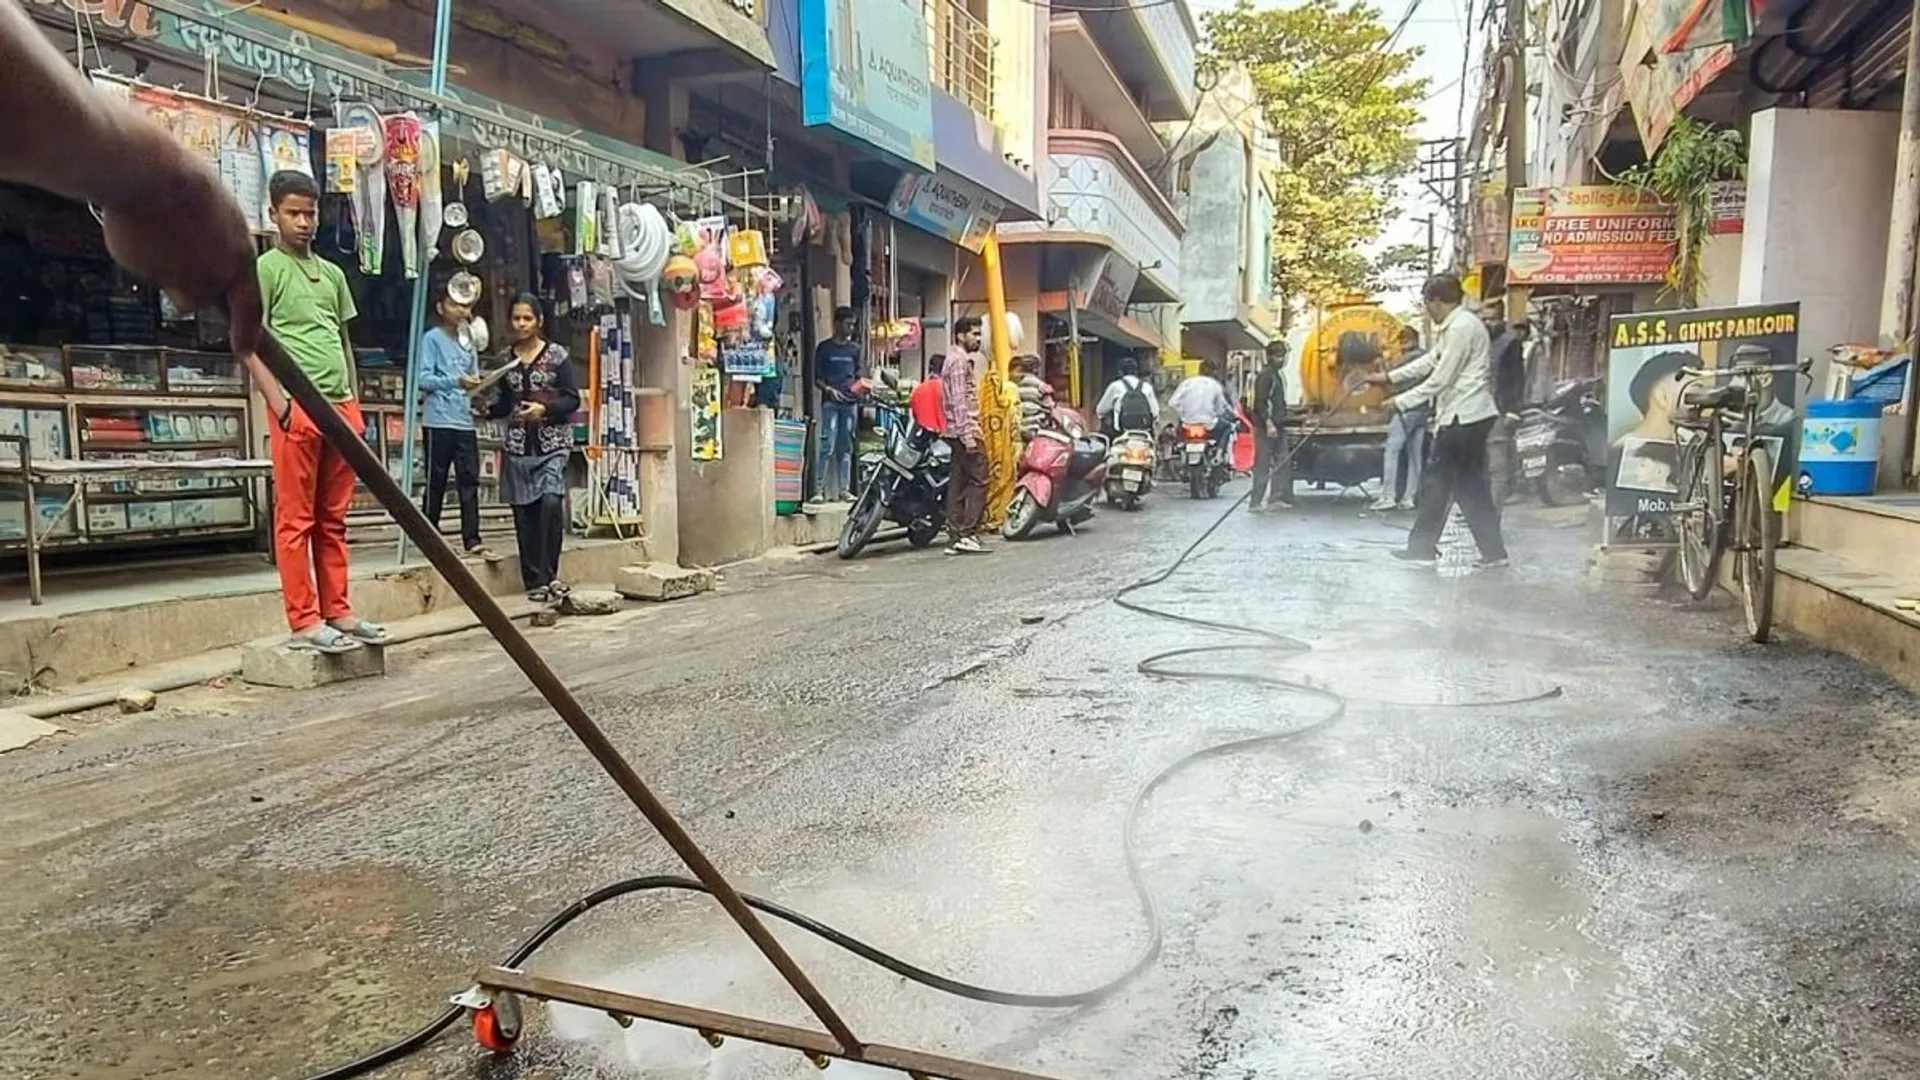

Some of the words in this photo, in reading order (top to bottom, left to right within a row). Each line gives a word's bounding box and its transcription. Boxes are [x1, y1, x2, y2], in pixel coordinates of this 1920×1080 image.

[1567, 190, 1614, 208] Sapling
[1545, 218, 1590, 231] FREE
[1595, 217, 1677, 230] UNIFORM
[1542, 231, 1563, 244] NO
[1567, 230, 1644, 244] ADMISSION
[1615, 319, 1673, 347] A.S.S.
[1679, 320, 1723, 342] GENTS
[1726, 314, 1796, 338] PARLOUR
[1638, 498, 1670, 512] Mob.
